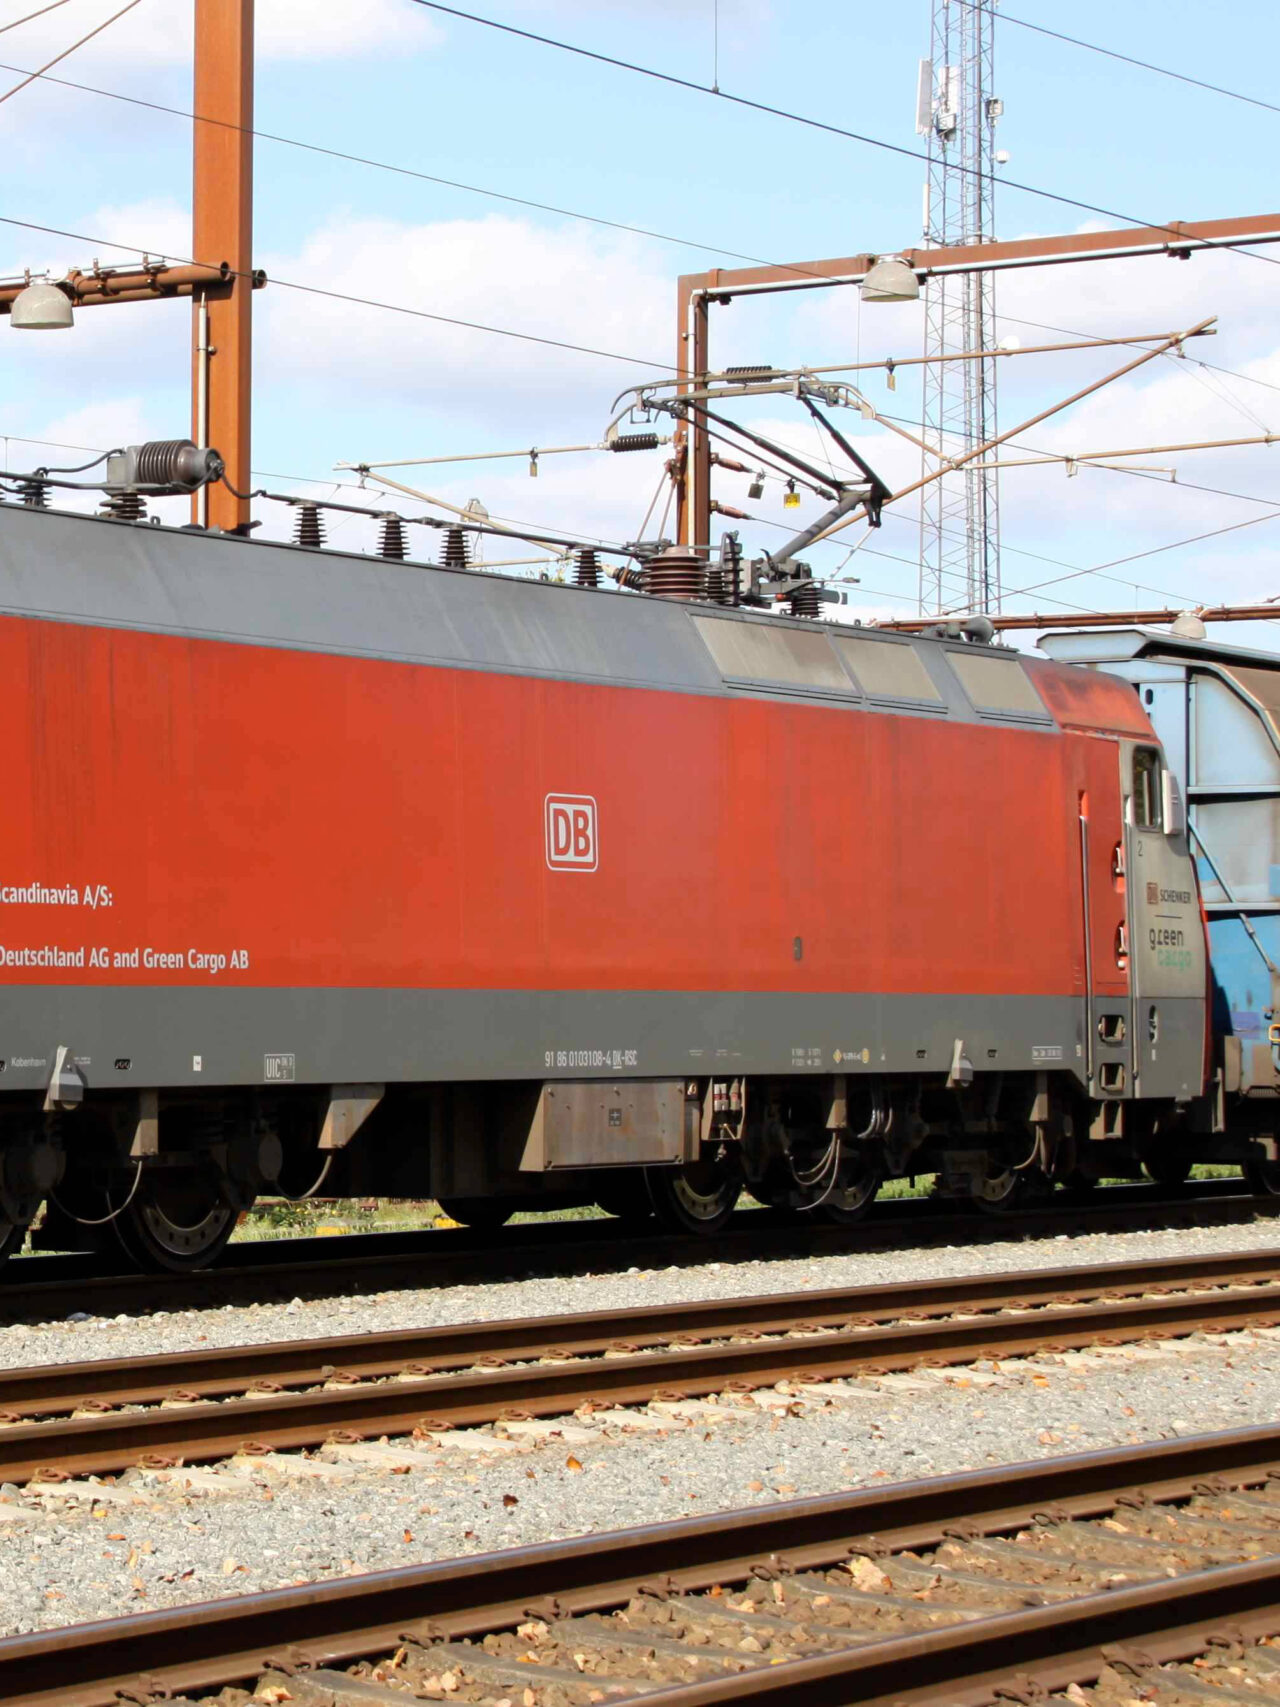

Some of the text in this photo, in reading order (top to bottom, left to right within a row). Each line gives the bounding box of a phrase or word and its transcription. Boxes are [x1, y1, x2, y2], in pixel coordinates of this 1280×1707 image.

[552, 807, 592, 859] DB
[82, 885, 113, 909] A/S:
[1160, 889, 1191, 904] SCHENKER
[1149, 927, 1185, 951] green
[88, 947, 110, 968] AG
[113, 947, 140, 969] and
[143, 948, 184, 969] Green
[187, 949, 226, 974] Cargo
[230, 950, 249, 969] AB
[1157, 949, 1192, 973] cargo
[266, 1057, 281, 1078] UIC
[544, 1050, 554, 1067] 91
[557, 1050, 567, 1067] 86
